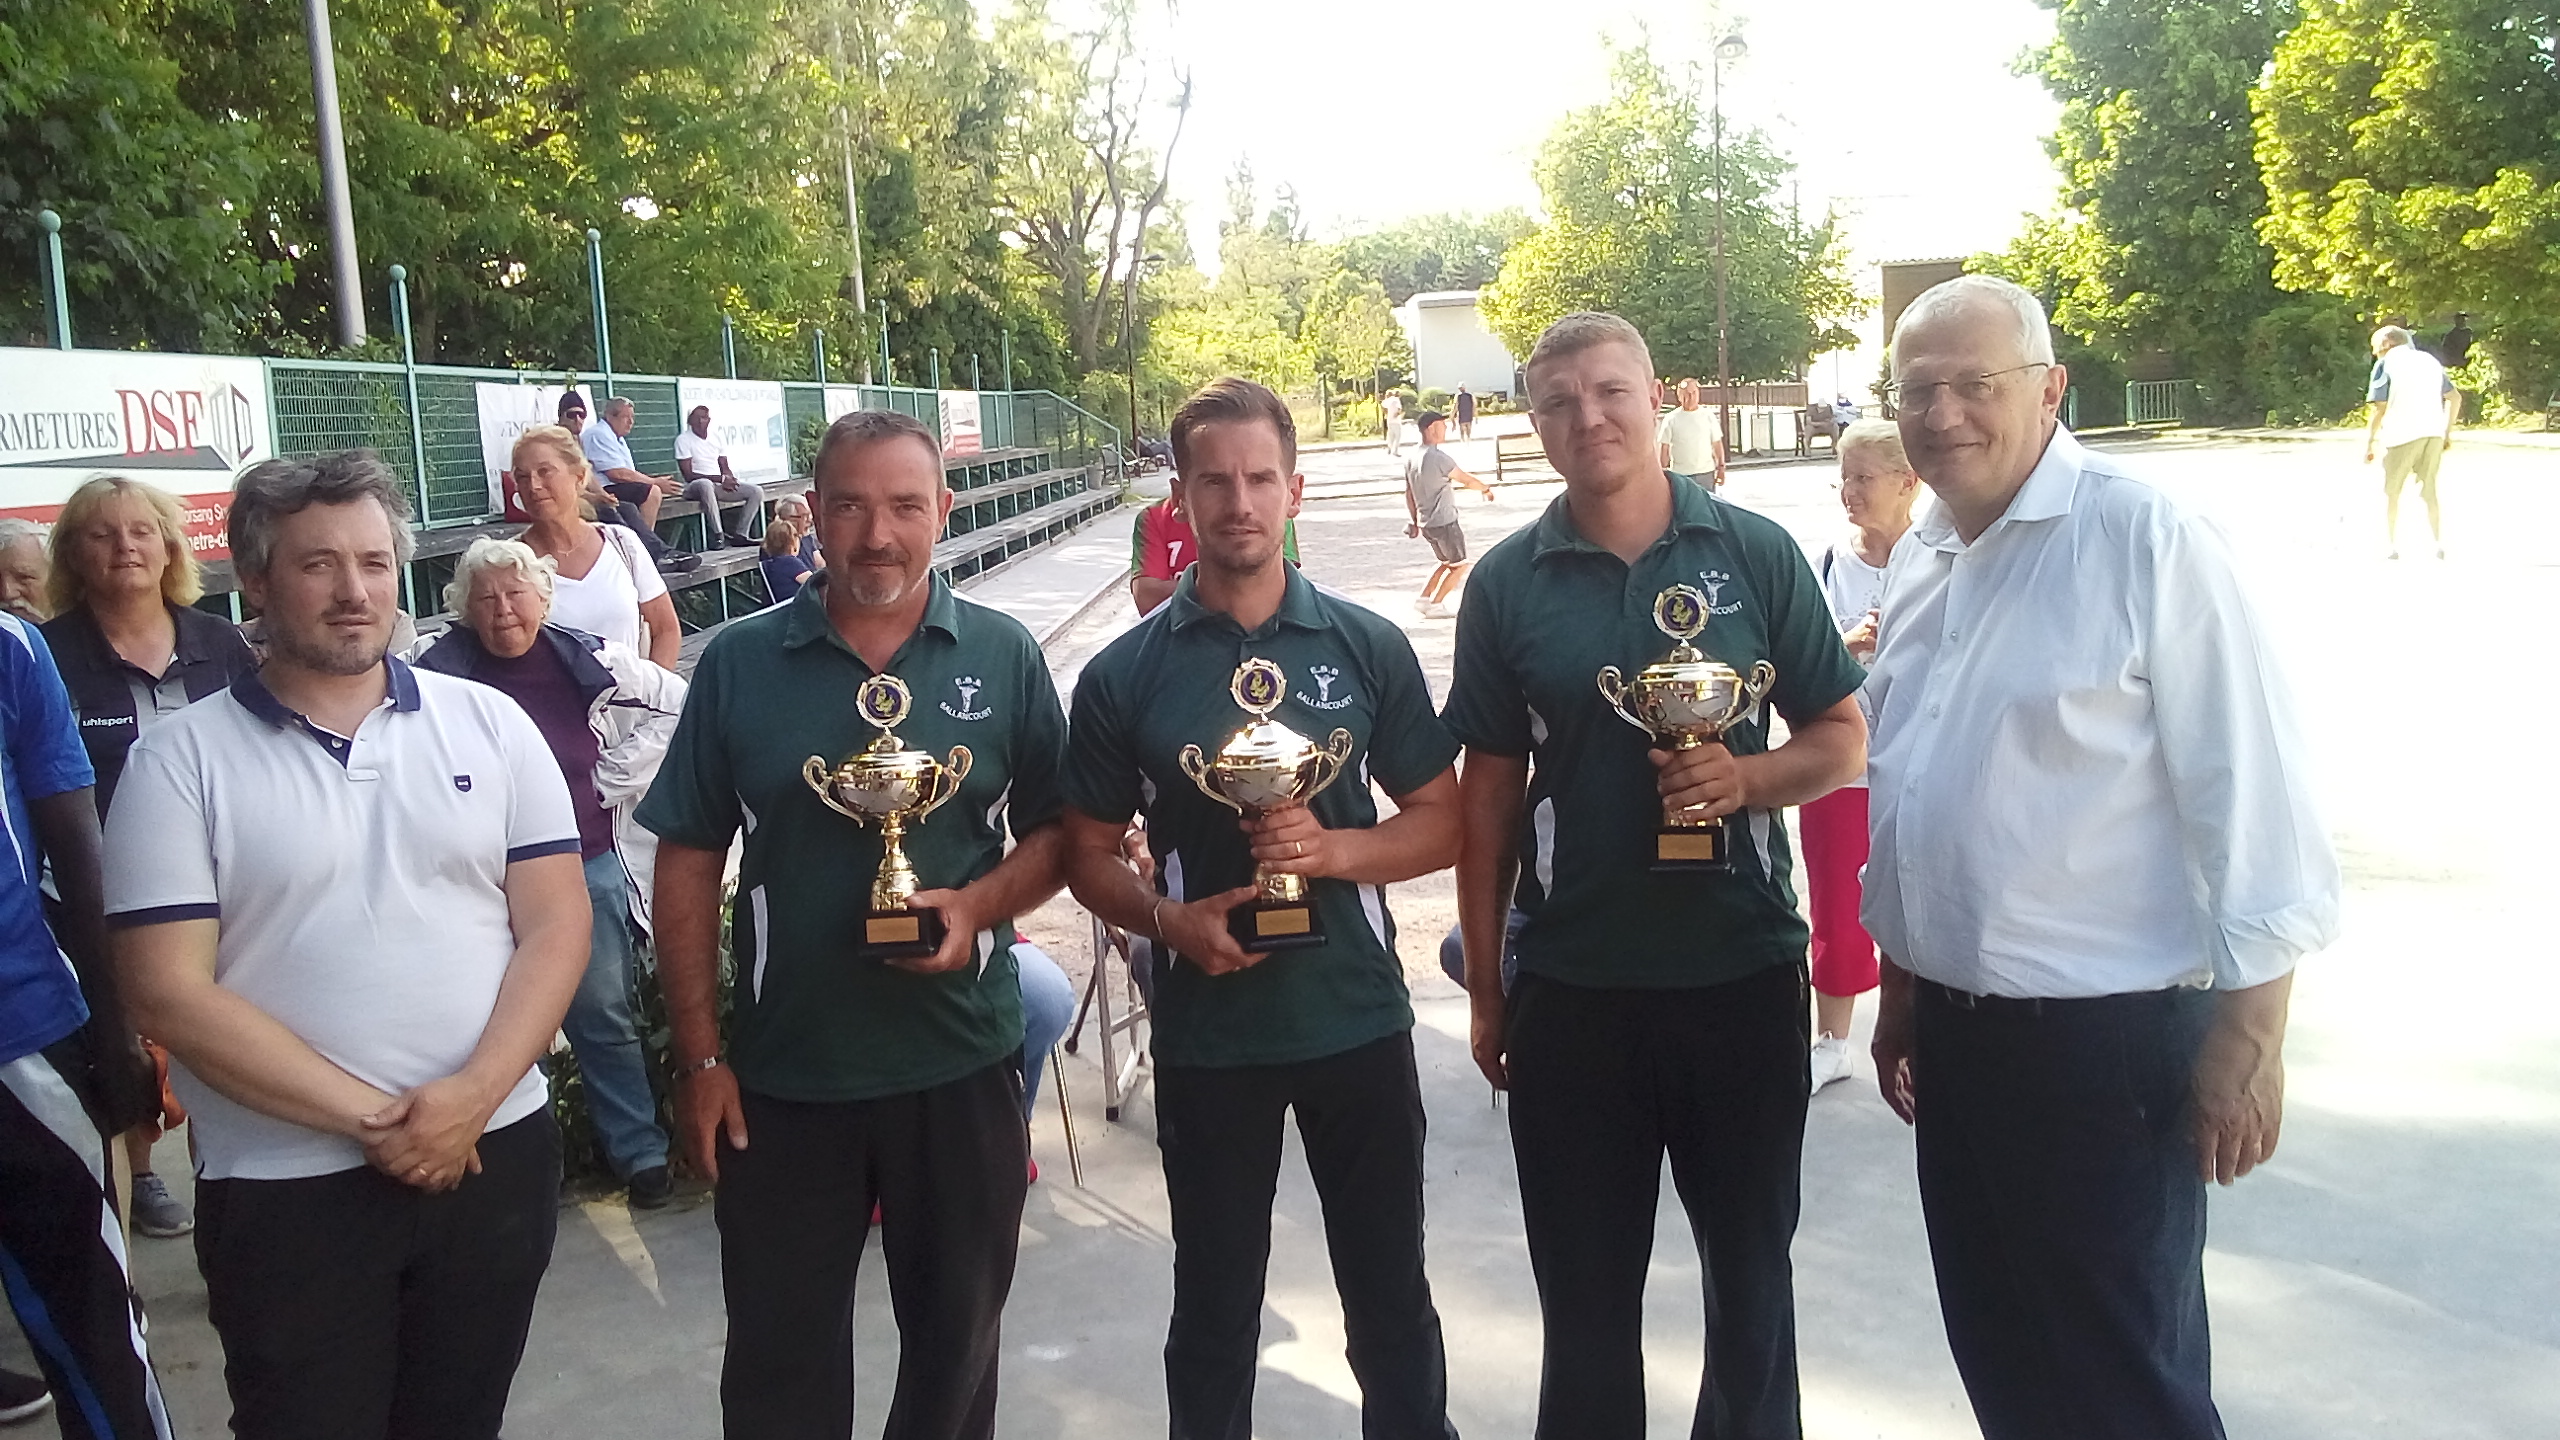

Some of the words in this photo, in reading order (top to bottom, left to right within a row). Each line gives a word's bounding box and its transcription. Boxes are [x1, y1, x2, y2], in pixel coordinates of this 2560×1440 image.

[115, 389, 205, 458] DSF
[183, 508, 214, 526] orsang
[1167, 541, 1183, 568] 7
[1296, 690, 1353, 710] BALLANCOURT
[82, 715, 134, 727] uhlsport
[939, 701, 993, 721] BALLANCOURT
